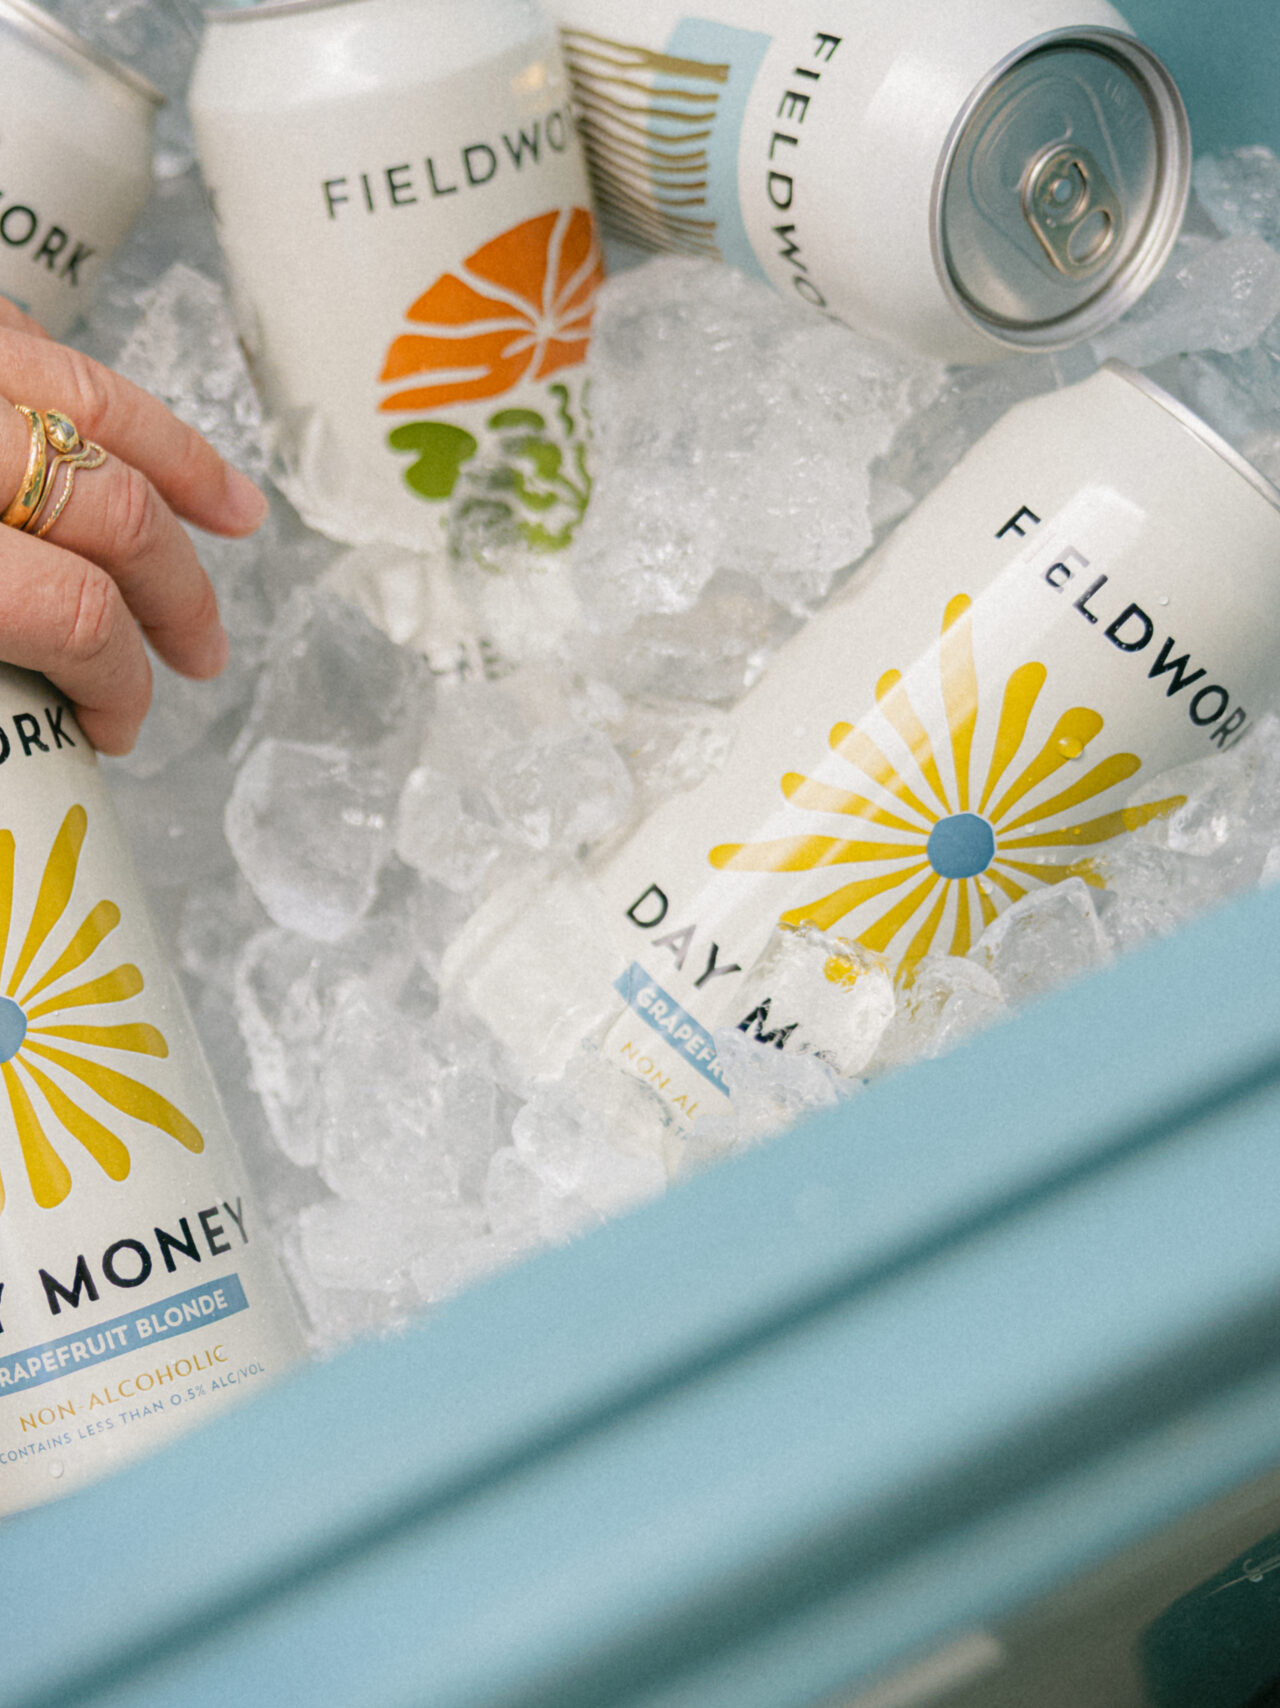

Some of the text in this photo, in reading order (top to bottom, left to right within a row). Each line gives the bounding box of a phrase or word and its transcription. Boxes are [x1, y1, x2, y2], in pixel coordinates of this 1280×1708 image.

[323, 104, 571, 219] FIELDWO
[767, 32, 842, 309] FIELDWO
[626, 883, 742, 989] DAY
[39, 1196, 249, 1316] MONEY
[135, 1289, 229, 1339] BLONDE
[19, 1344, 229, 1432] NON-ALCOHOLIC
[78, 1418, 115, 1440] LESS
[119, 1399, 164, 1424] THAN
[170, 1383, 207, 1406] 0.5%
[211, 1361, 266, 1392] ALC/VOL
